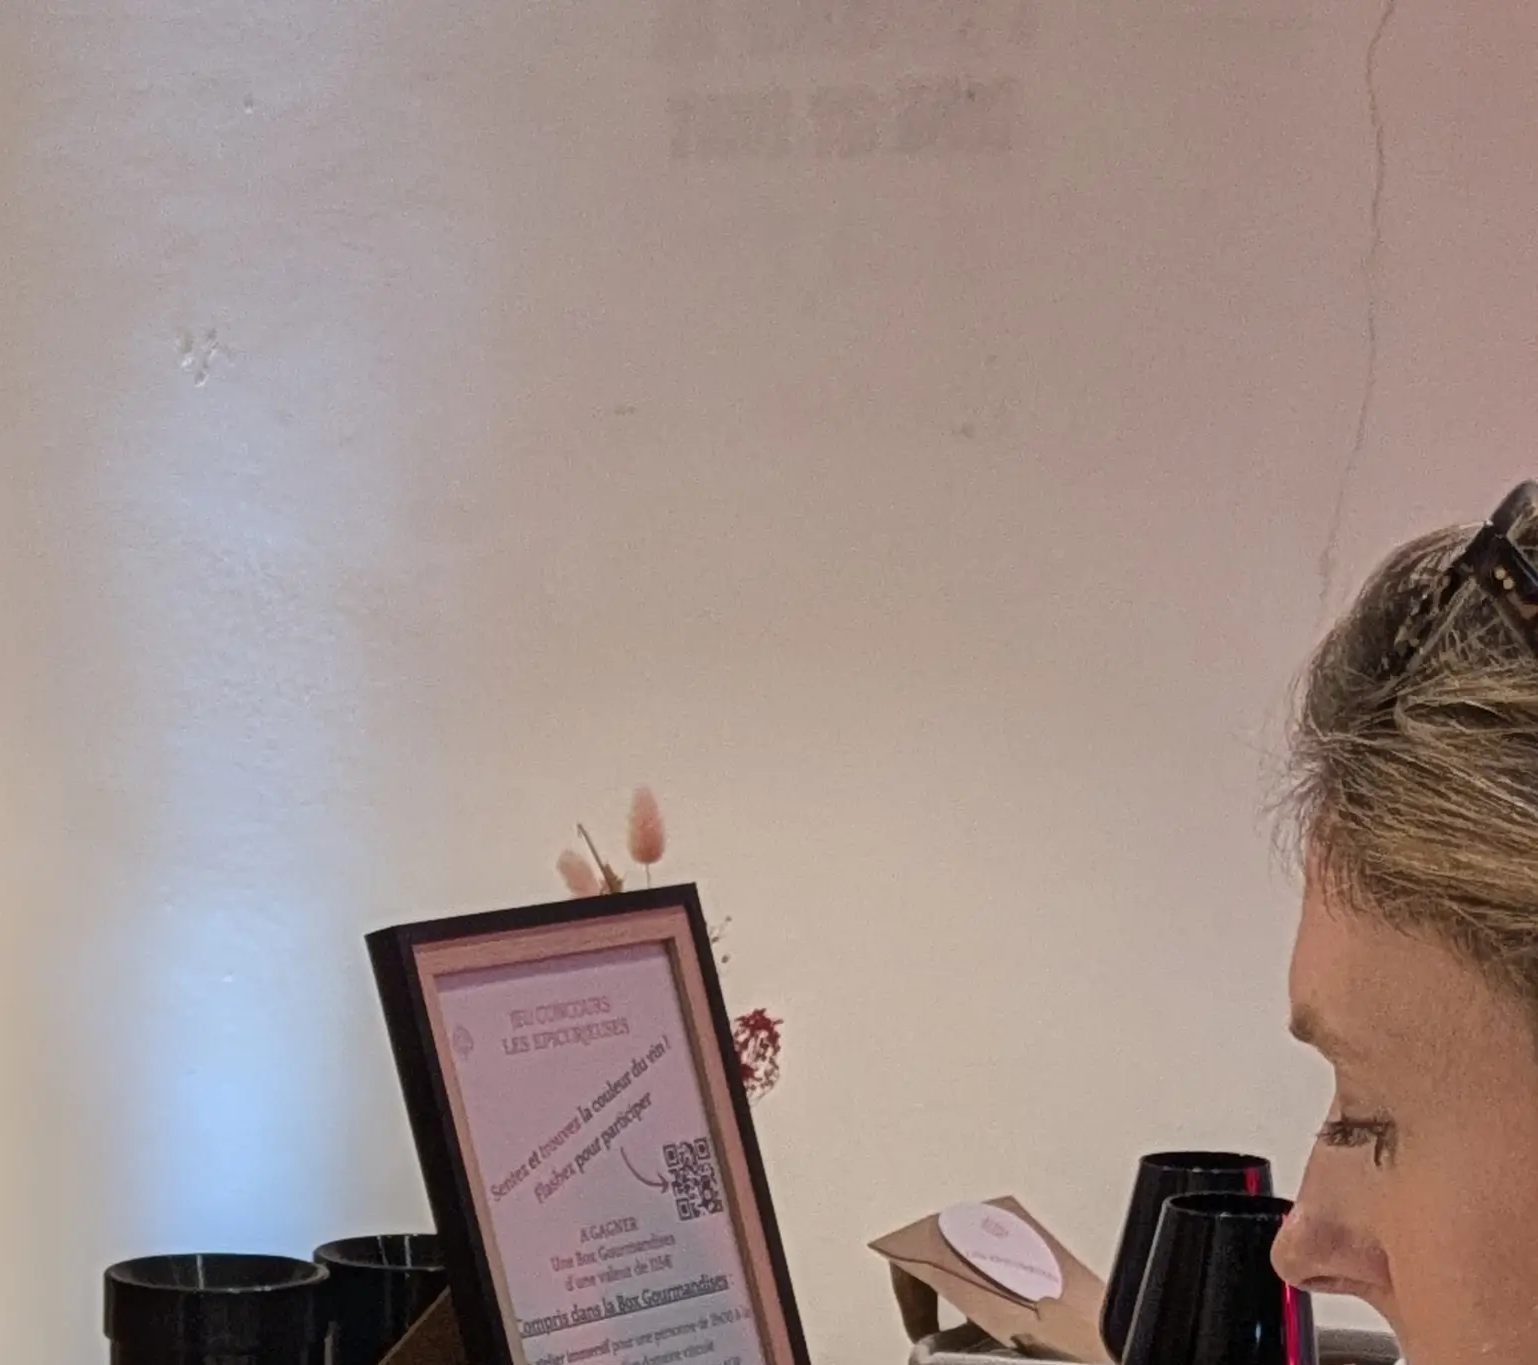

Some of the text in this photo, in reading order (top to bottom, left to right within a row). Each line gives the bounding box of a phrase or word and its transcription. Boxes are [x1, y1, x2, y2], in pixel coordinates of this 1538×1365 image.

[502, 1036, 531, 1055] LES
[490, 1163, 530, 1201] Sentez
[528, 1150, 542, 1170] et
[538, 1117, 582, 1160] trouvez
[577, 1105, 593, 1125] la
[592, 1071, 632, 1113] couleur
[630, 1057, 649, 1078] du
[574, 1135, 603, 1174] pour
[600, 1091, 652, 1151] participer
[590, 1216, 639, 1241] GAGNER
[549, 1256, 574, 1272] Une
[575, 1250, 597, 1267] Box
[571, 1303, 602, 1327] dans
[601, 1294, 616, 1317] la
[616, 1293, 643, 1313] Box
[641, 1273, 730, 1304] Gourmandises
